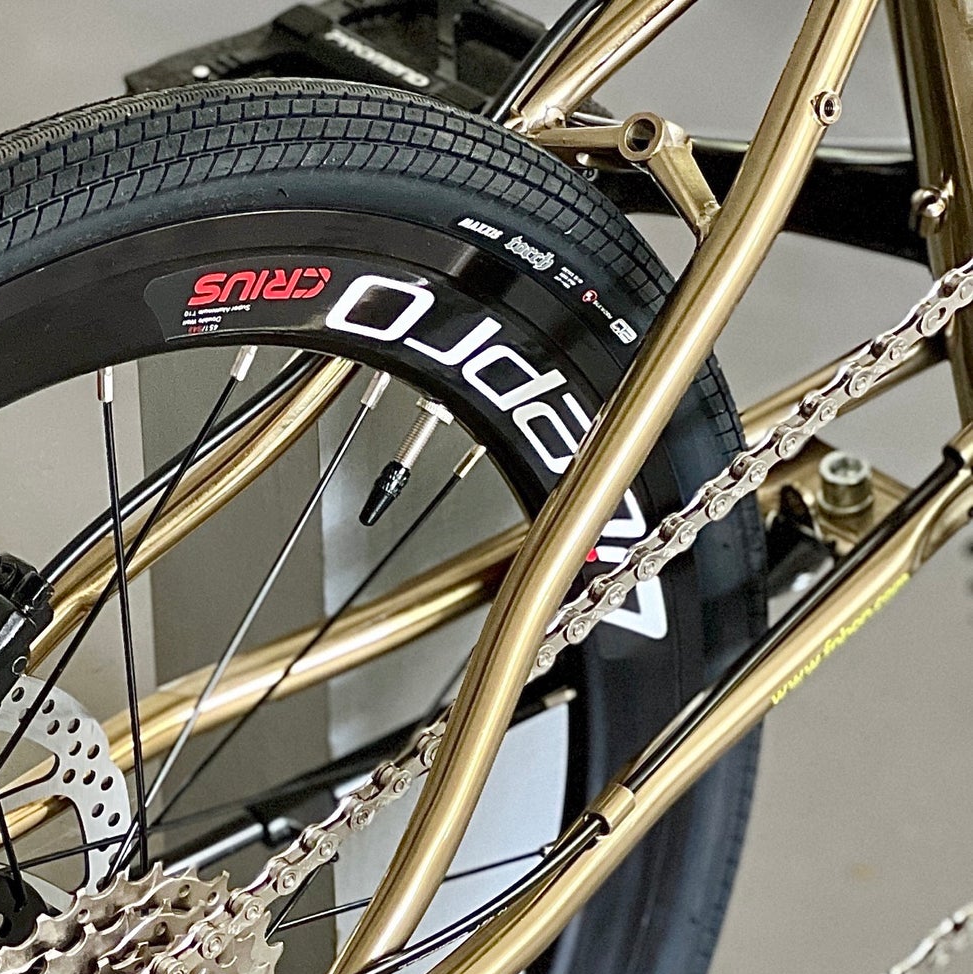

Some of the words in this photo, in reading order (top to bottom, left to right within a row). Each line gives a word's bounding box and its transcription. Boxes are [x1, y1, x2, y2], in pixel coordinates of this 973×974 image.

[457, 217, 504, 240] MAXXIS
[504, 235, 556, 271] torch
[188, 266, 332, 306] CRIUS
